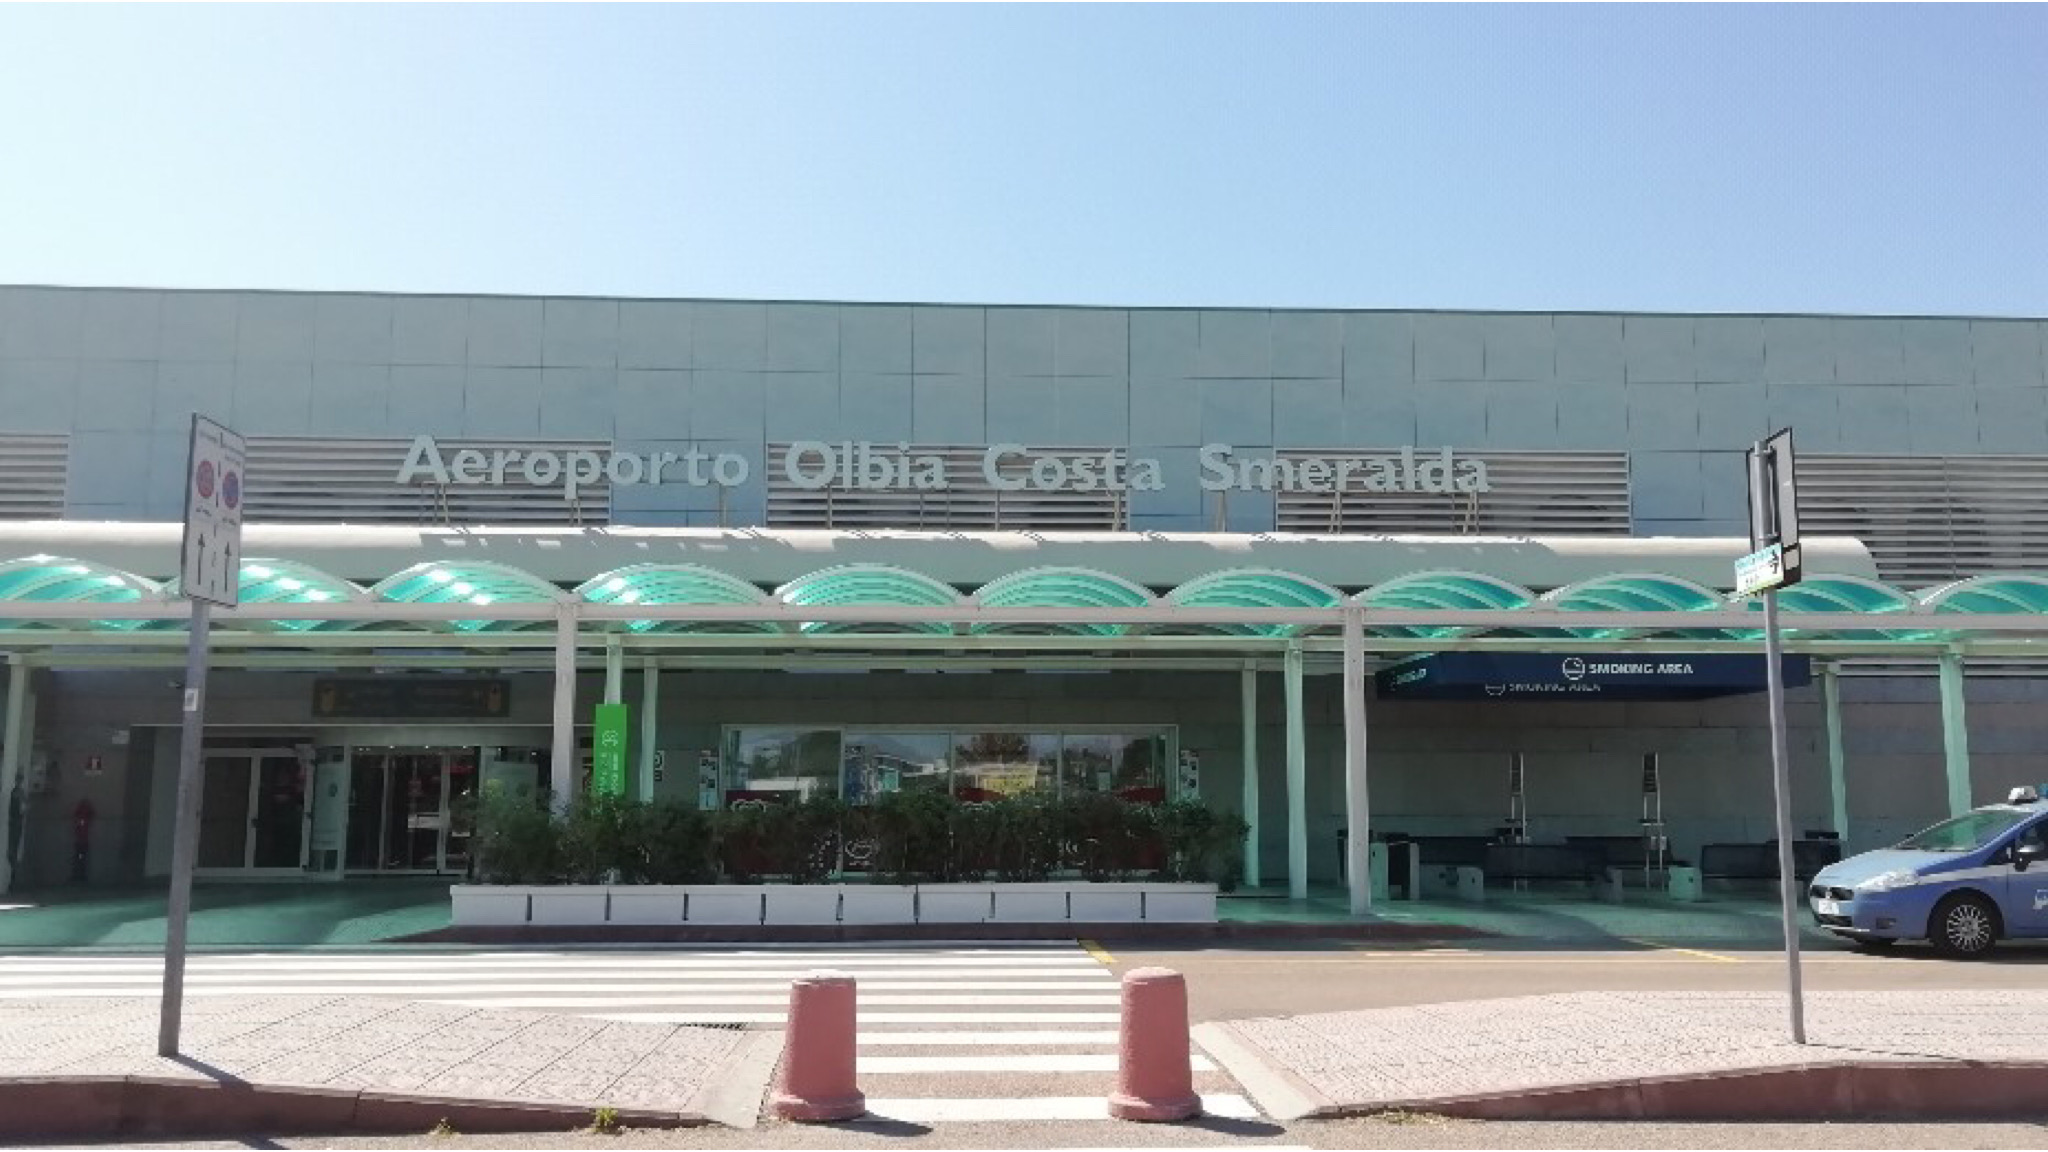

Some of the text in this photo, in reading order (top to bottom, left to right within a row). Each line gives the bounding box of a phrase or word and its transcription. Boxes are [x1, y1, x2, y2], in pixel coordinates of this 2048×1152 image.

[397, 435, 1491, 500] Aeroporto Olbia Costa Smeralda
[1588, 663, 1694, 674] SMOKING AREA
